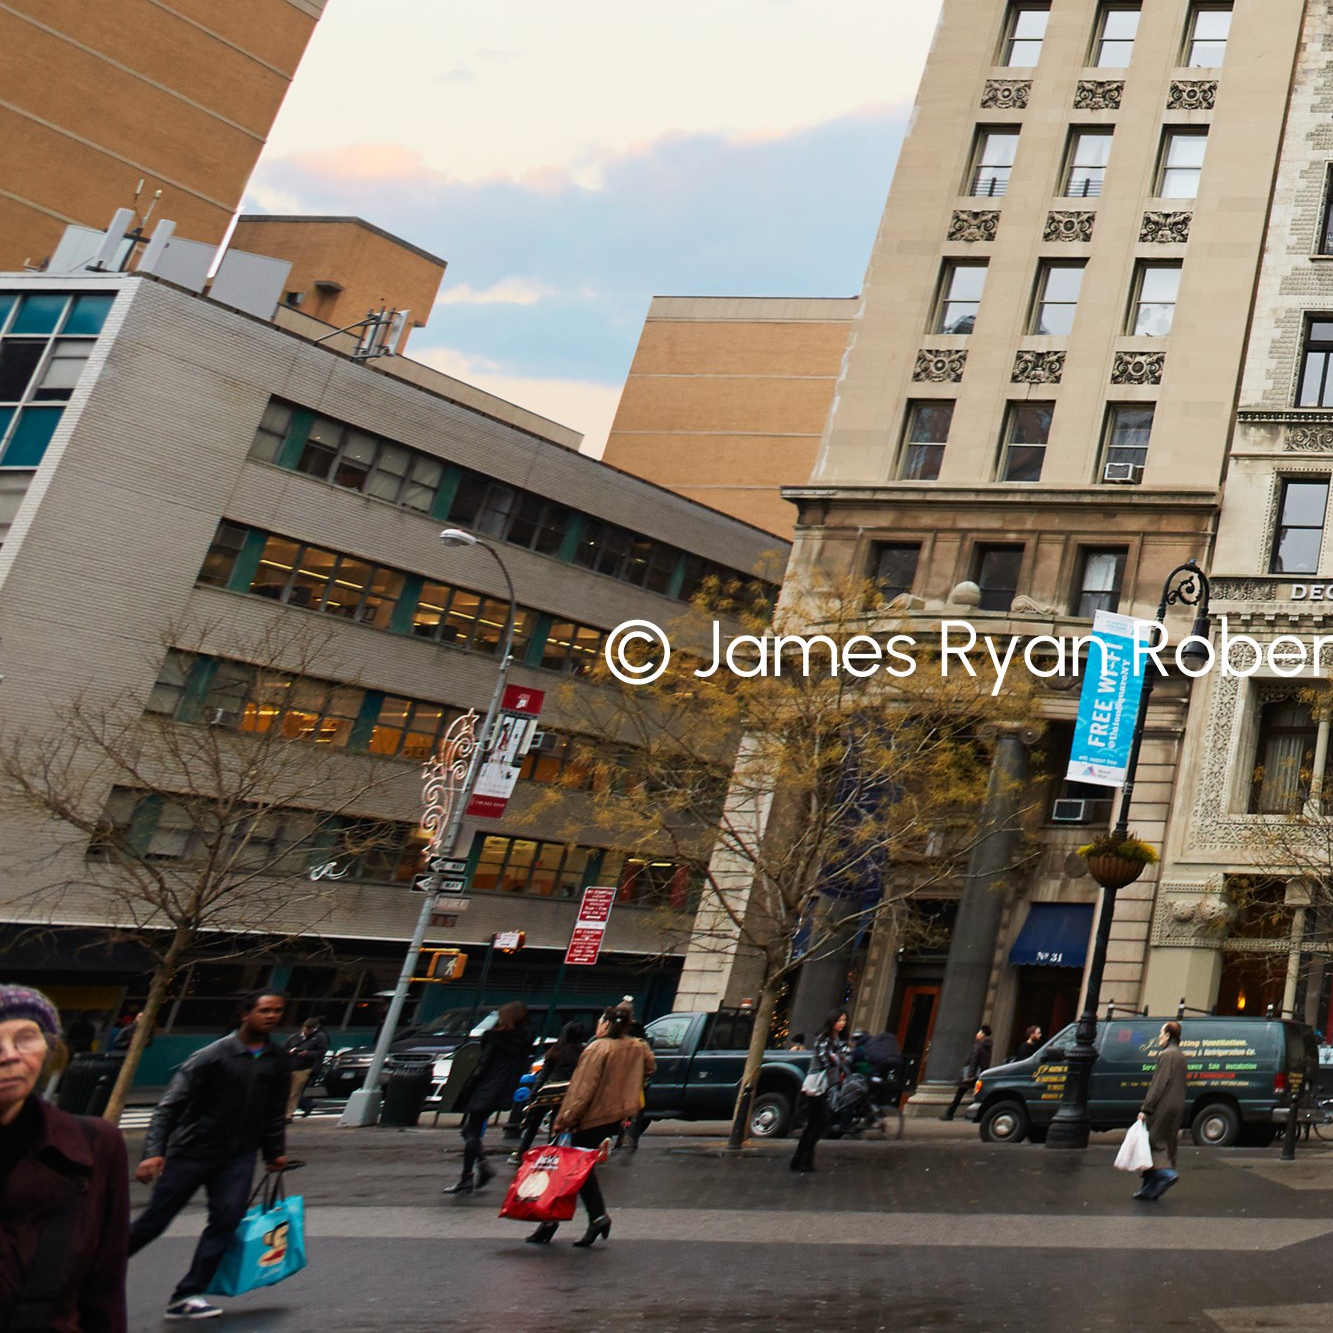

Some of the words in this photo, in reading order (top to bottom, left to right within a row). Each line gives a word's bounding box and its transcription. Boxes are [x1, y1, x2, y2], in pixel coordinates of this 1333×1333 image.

[1087, 698, 1114, 748] FREE
[1107, 659, 1131, 749] @UnionSquareNY
[1050, 952, 1063, 963] 31
